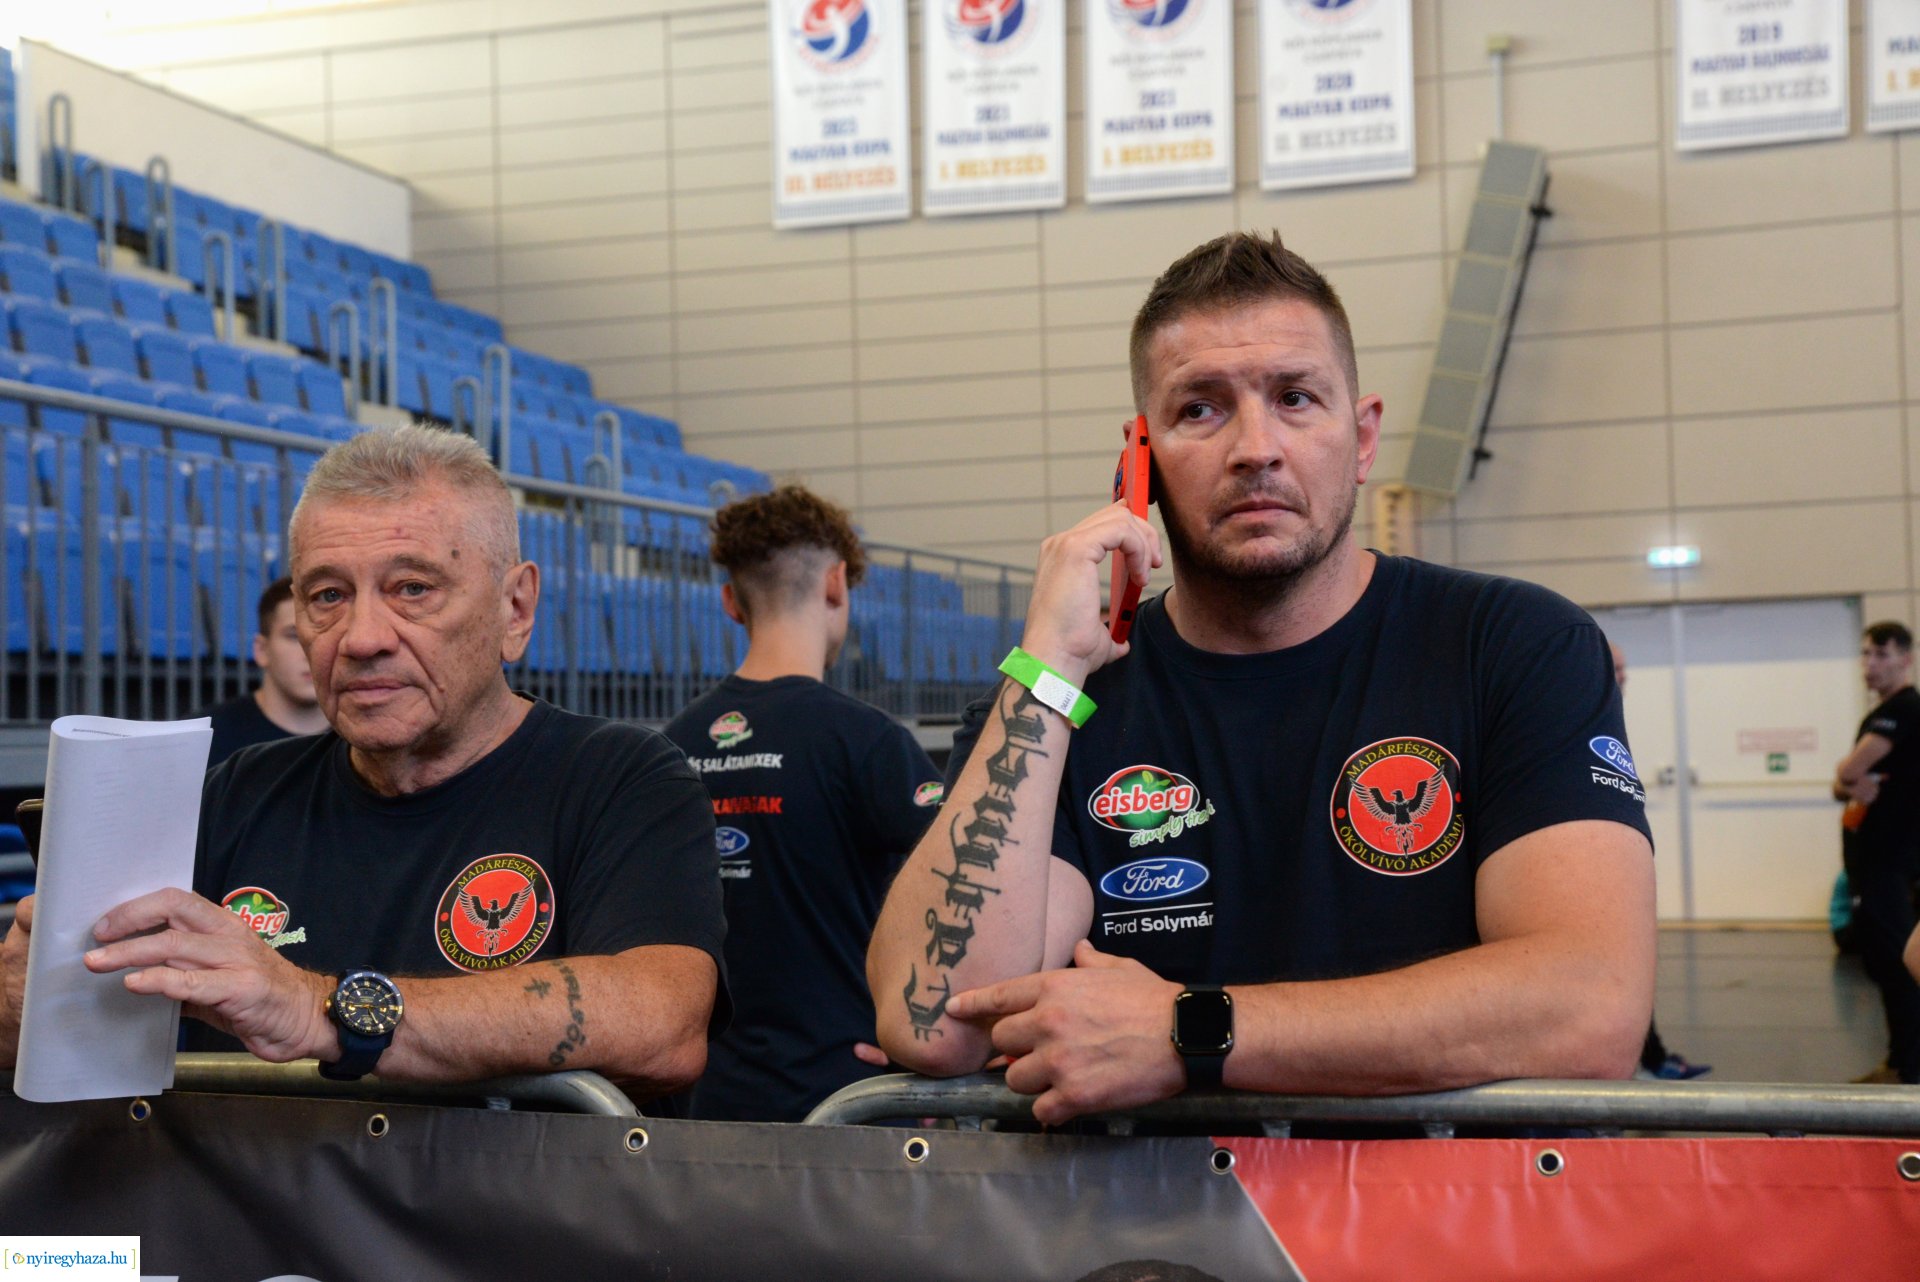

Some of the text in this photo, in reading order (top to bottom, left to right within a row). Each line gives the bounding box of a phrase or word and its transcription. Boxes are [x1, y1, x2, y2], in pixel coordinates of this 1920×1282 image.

[1346, 741, 1446, 779] MADÁRFÉSZEK
[1592, 772, 1619, 789] Ford
[1094, 784, 1193, 817] eisberg
[1129, 815, 1184, 848] simply
[1409, 813, 1463, 870] AKADÉMIA
[458, 858, 538, 888] MADÁRFÉSZEK
[1123, 863, 1185, 894] Ford
[1104, 910, 1214, 936] Ford Solymár
